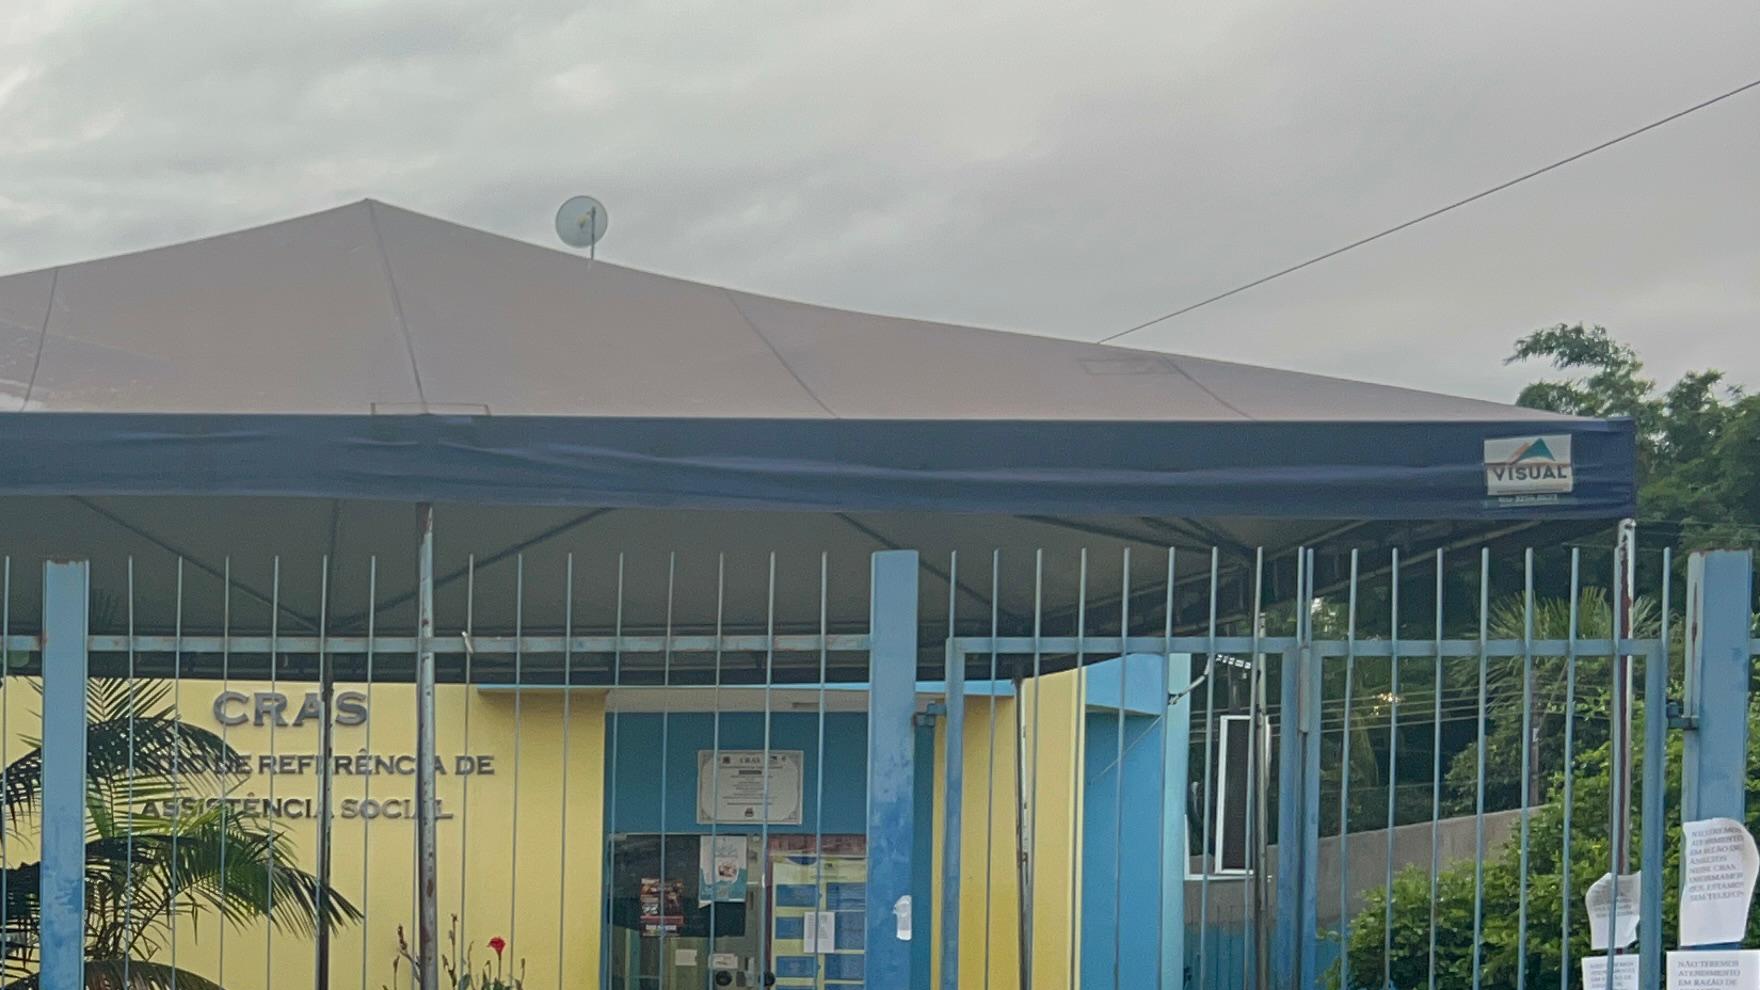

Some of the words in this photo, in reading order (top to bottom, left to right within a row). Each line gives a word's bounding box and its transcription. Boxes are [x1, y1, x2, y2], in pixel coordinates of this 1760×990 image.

[1492, 465, 1568, 481] VISUAL
[213, 691, 368, 726] CRAS
[259, 748, 447, 776] REFRÊNCA
[455, 755, 495, 776] DE
[142, 792, 334, 820] ASSITÊNCI
[341, 798, 454, 820] SOCIL
